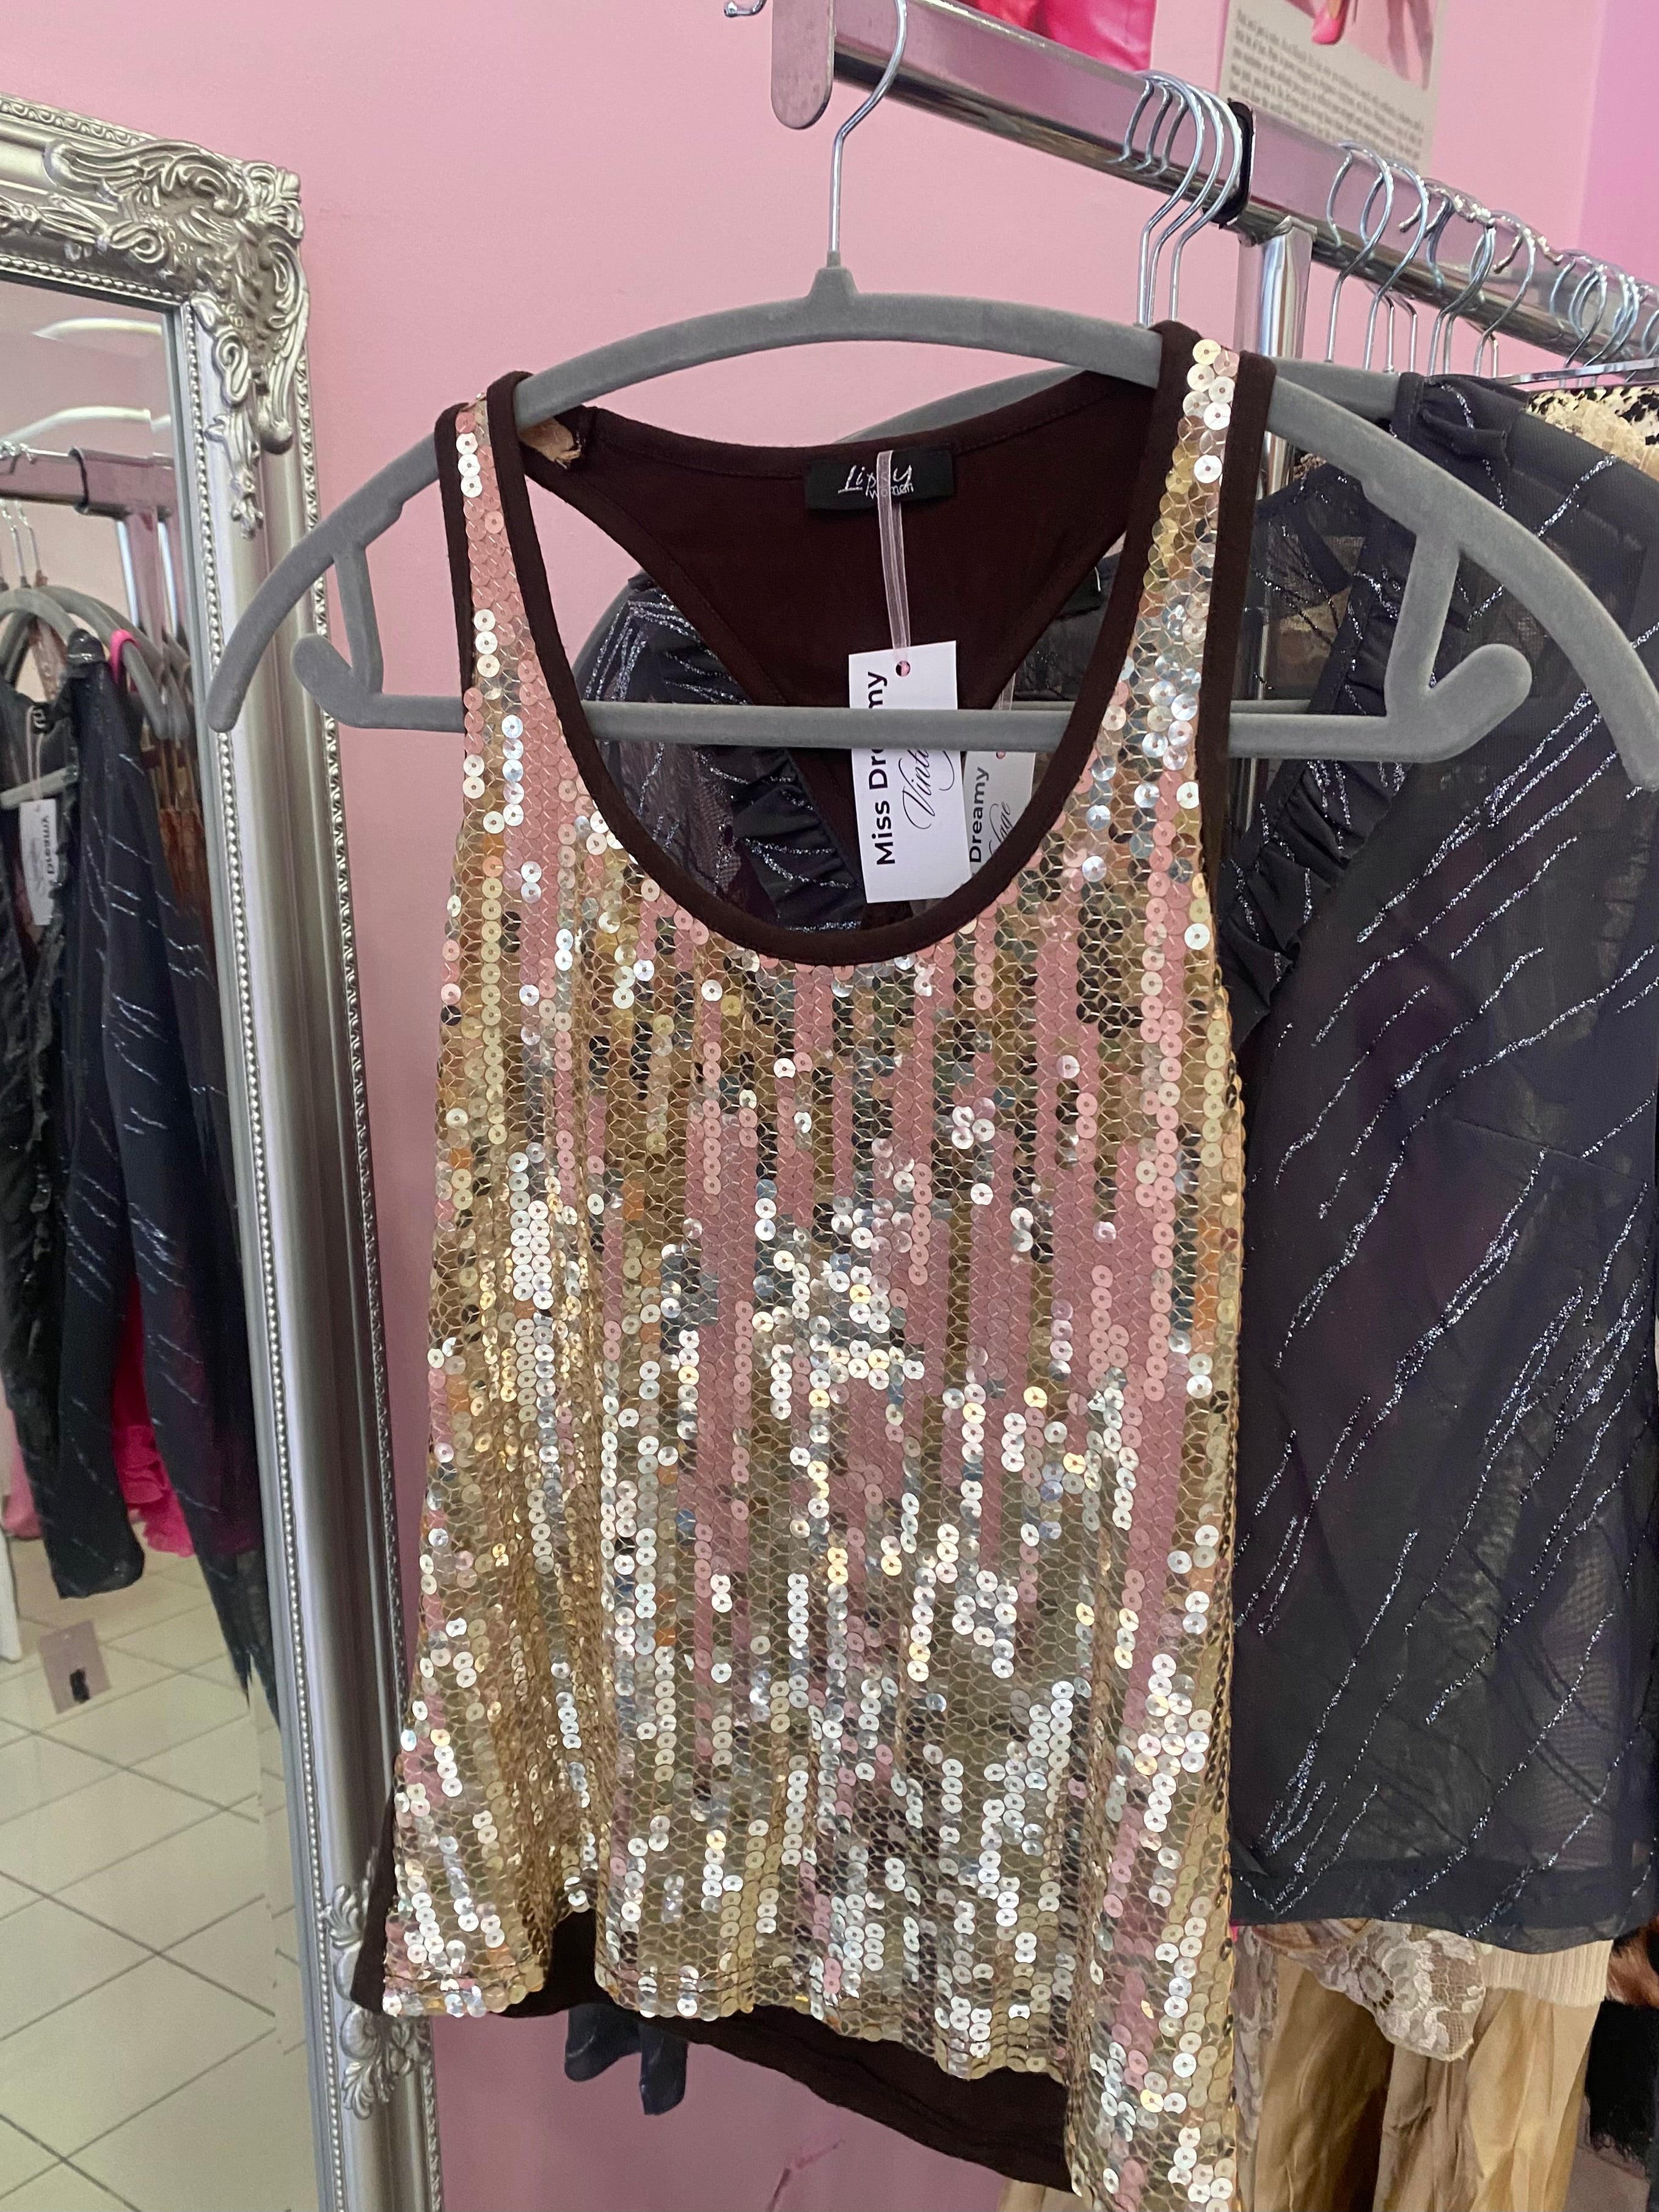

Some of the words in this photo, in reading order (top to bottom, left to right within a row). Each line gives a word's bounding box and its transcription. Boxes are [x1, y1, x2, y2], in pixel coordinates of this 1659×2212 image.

[868, 671, 888, 790] Drmy
[872, 800, 895, 865] Miss
[969, 767, 989, 863] Dreamy
